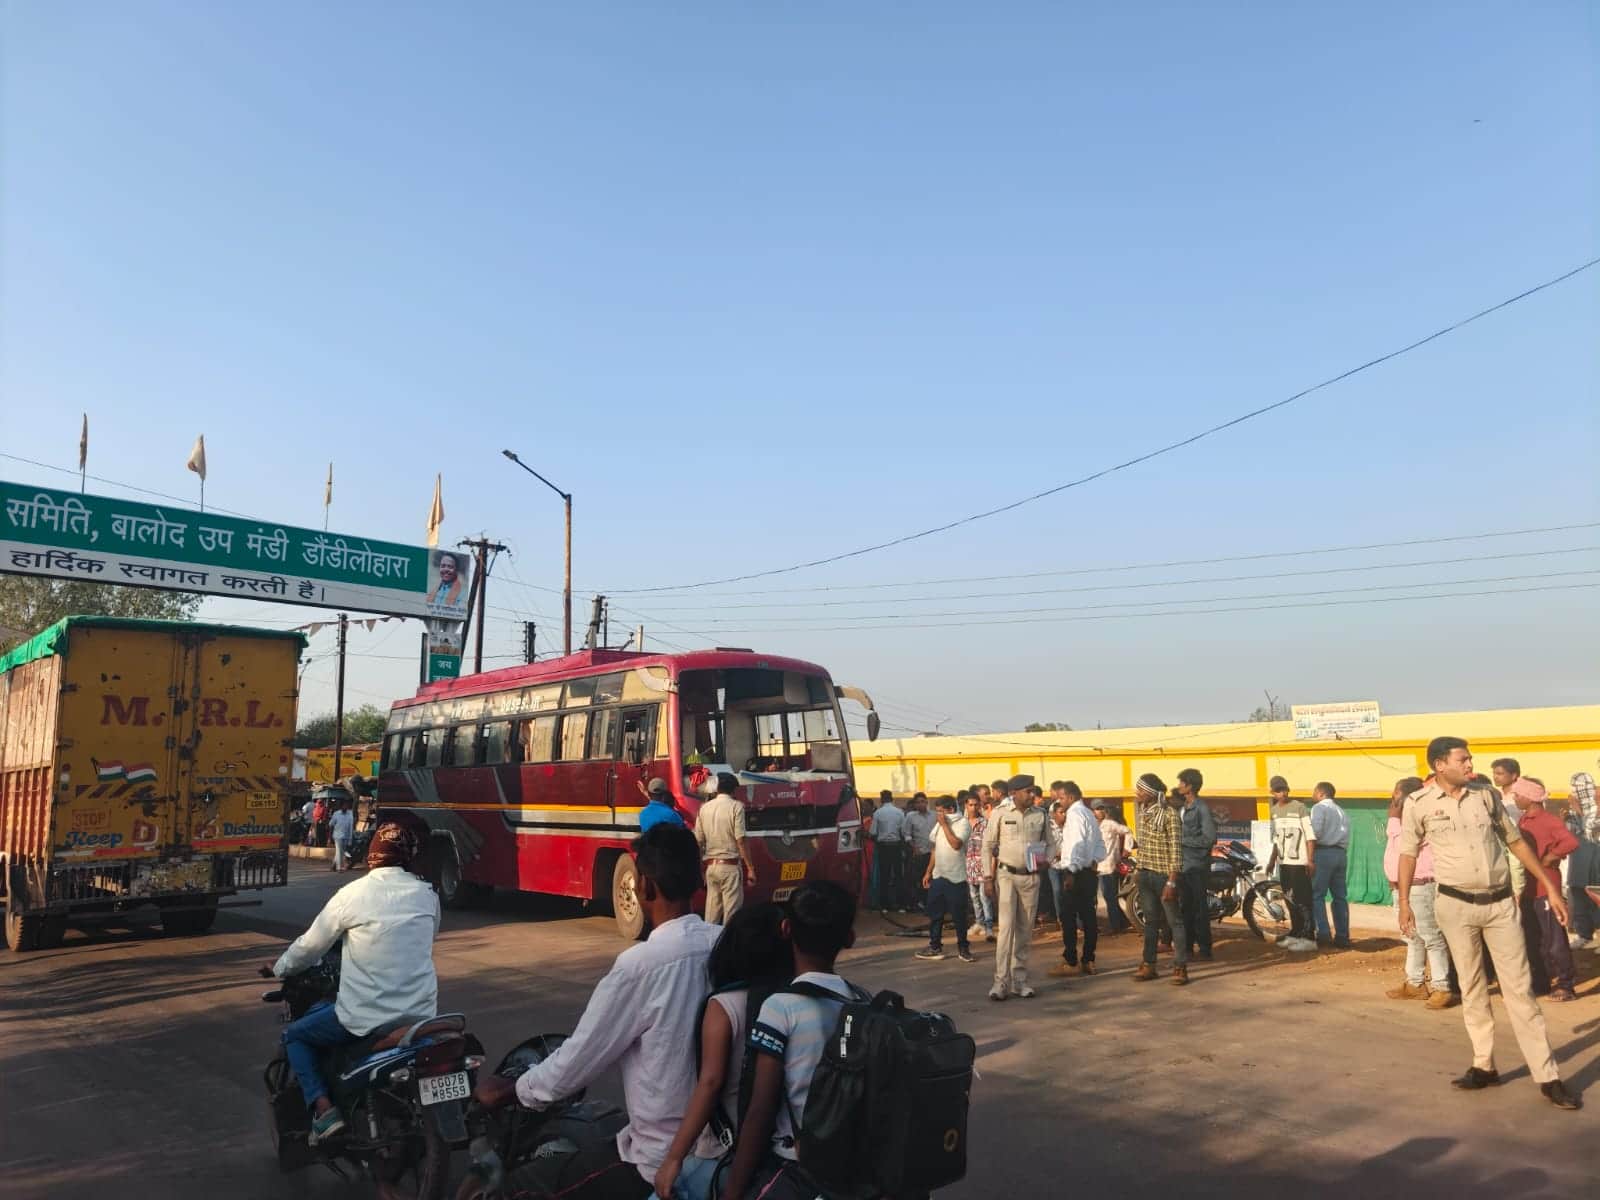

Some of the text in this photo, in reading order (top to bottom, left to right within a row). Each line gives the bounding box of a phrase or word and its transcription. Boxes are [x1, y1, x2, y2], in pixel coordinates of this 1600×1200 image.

[6, 493, 411, 579] समिति, बालोद उप मंडी डौंडीलोहारा
[10, 550, 106, 574] हार्दिक
[119, 562, 209, 586] स्वागत
[220, 574, 289, 596] करती
[437, 660, 453, 670] जय
[74, 812, 106, 828] STOP
[64, 831, 124, 848] Keep
